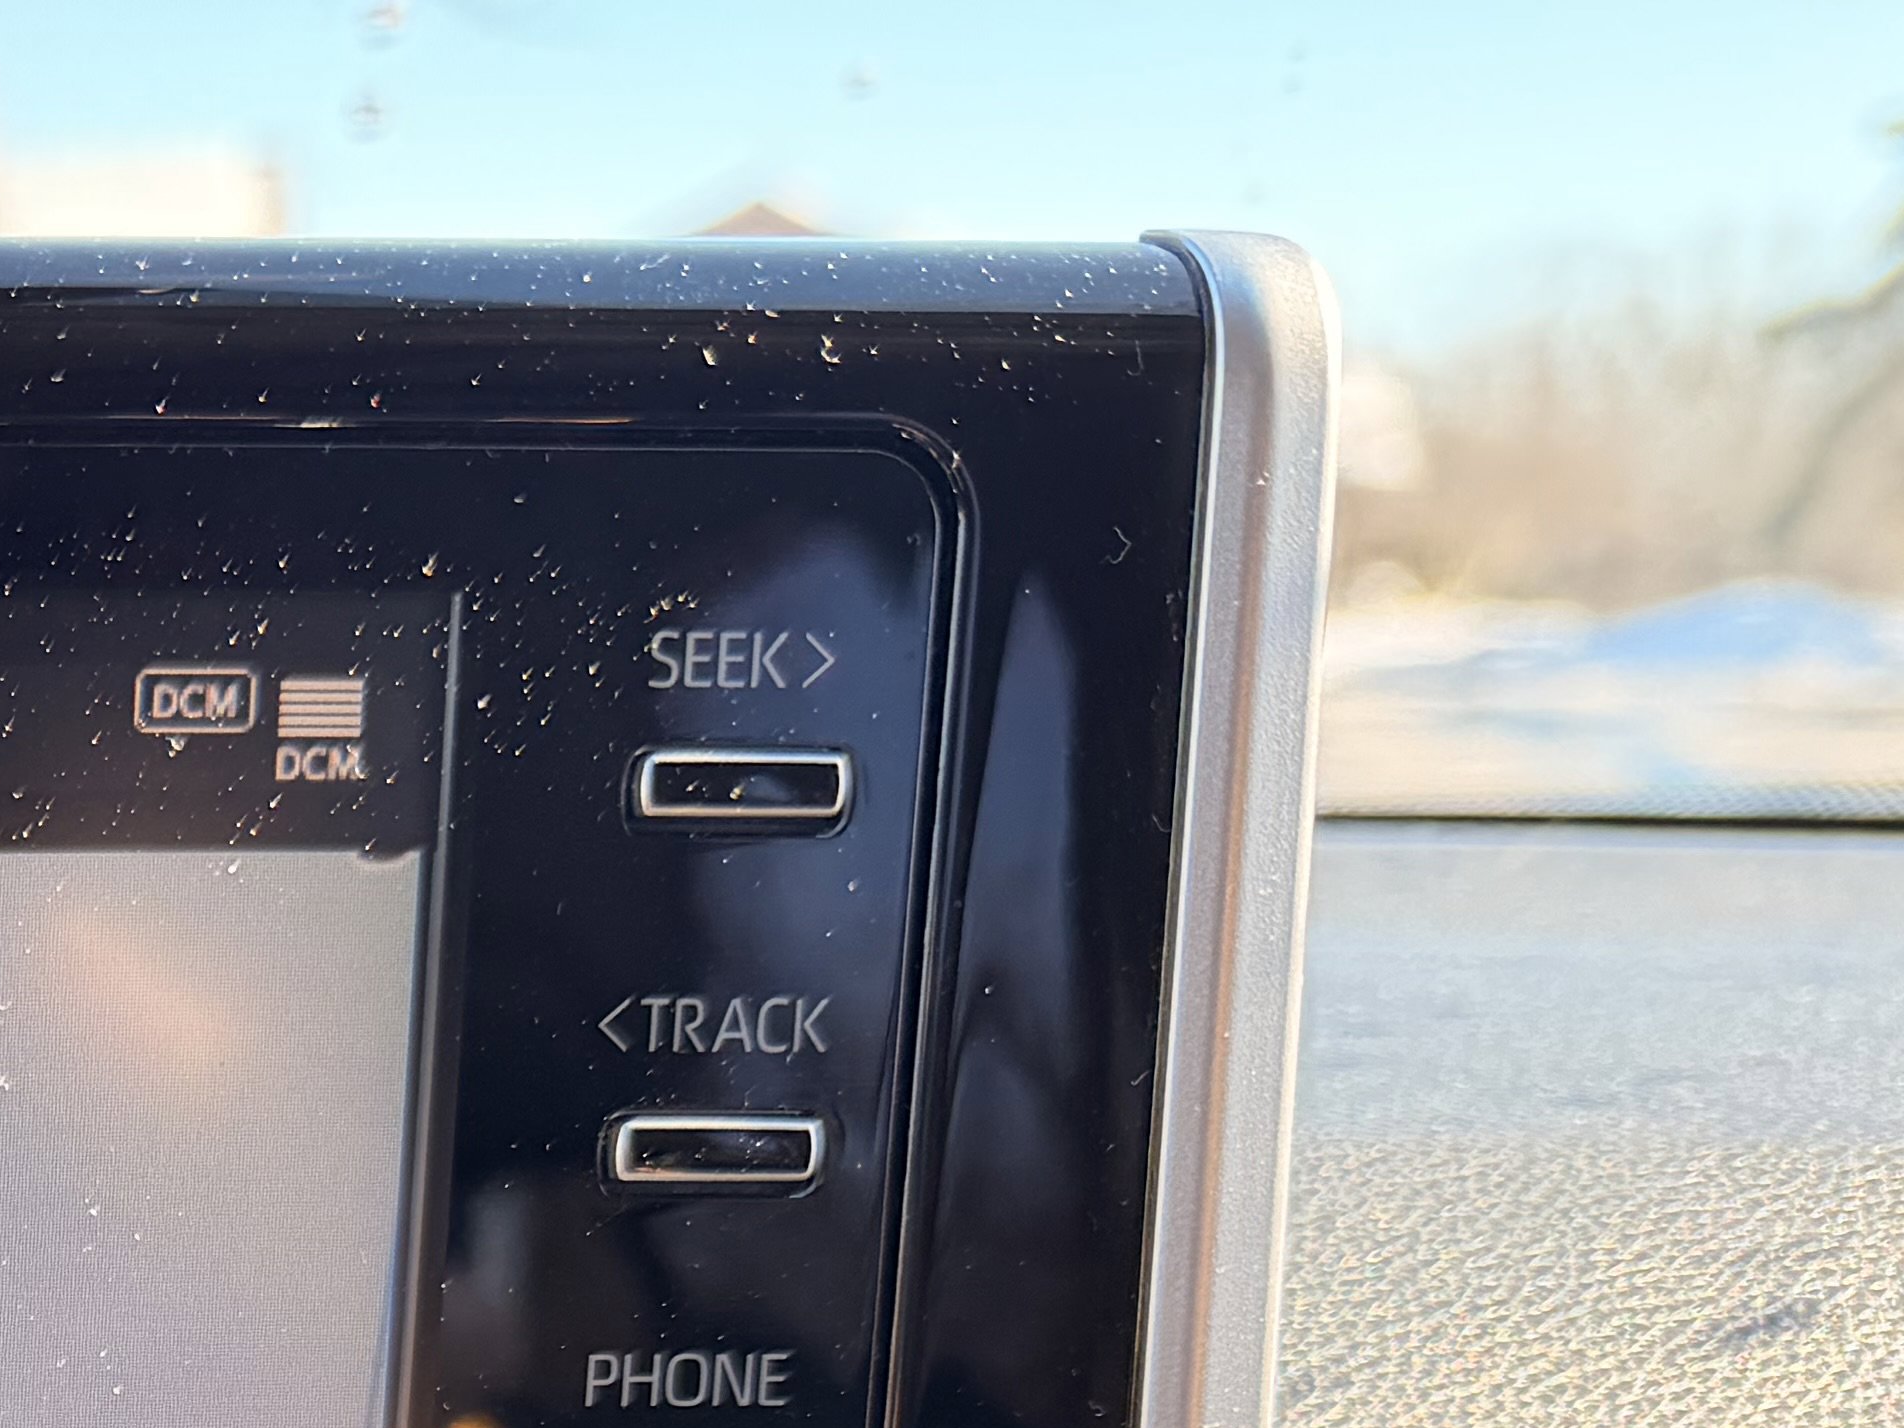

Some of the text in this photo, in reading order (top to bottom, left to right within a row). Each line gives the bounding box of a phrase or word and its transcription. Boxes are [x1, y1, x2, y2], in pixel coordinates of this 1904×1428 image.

[648, 630, 789, 689] SEEK
[151, 682, 239, 720] DCM
[275, 745, 362, 782] DCM
[640, 996, 833, 1054] TRACK
[584, 1350, 796, 1409] PHONE
